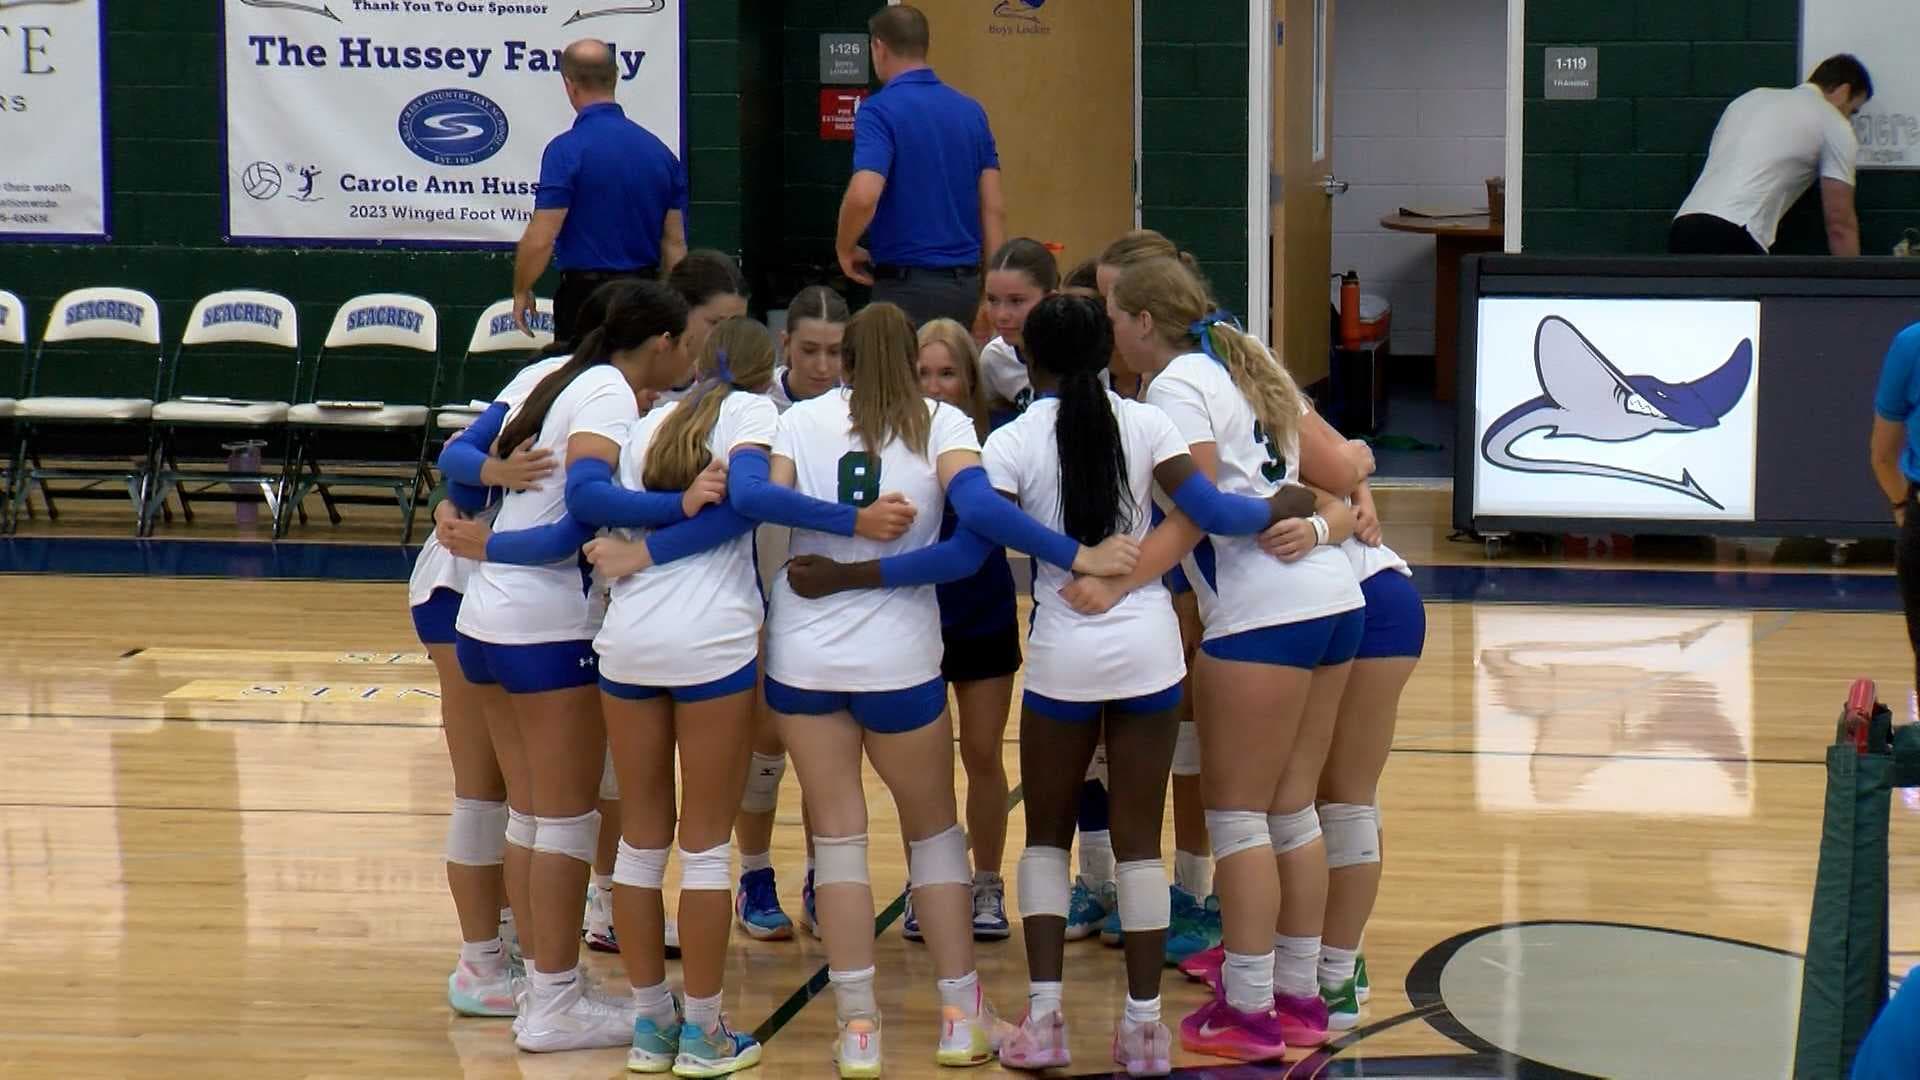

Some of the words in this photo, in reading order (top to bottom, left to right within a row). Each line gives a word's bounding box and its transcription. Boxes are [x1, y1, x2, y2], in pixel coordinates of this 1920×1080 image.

[353, 0, 399, 11] Thank
[403, 1, 431, 12] You
[435, 2, 453, 13] To
[457, 2, 484, 13] Our
[488, 2, 549, 16] Sponsor
[248, 35, 328, 67] The
[339, 37, 492, 78] Hussey
[503, 41, 646, 81] Faly
[830, 43, 860, 54] 1-126
[1556, 56, 1587, 70] 1-119
[340, 173, 418, 193] Carole
[424, 176, 475, 194] Ann
[481, 176, 541, 195] Huss
[349, 204, 388, 218] 2023
[392, 206, 455, 223] Winged
[460, 208, 496, 221] Foot
[501, 208, 533, 221] Win
[65, 300, 144, 327] SEACREST
[202, 302, 283, 330] SEACREST
[346, 306, 425, 334] SEACREST
[837, 450, 883, 509] 8
